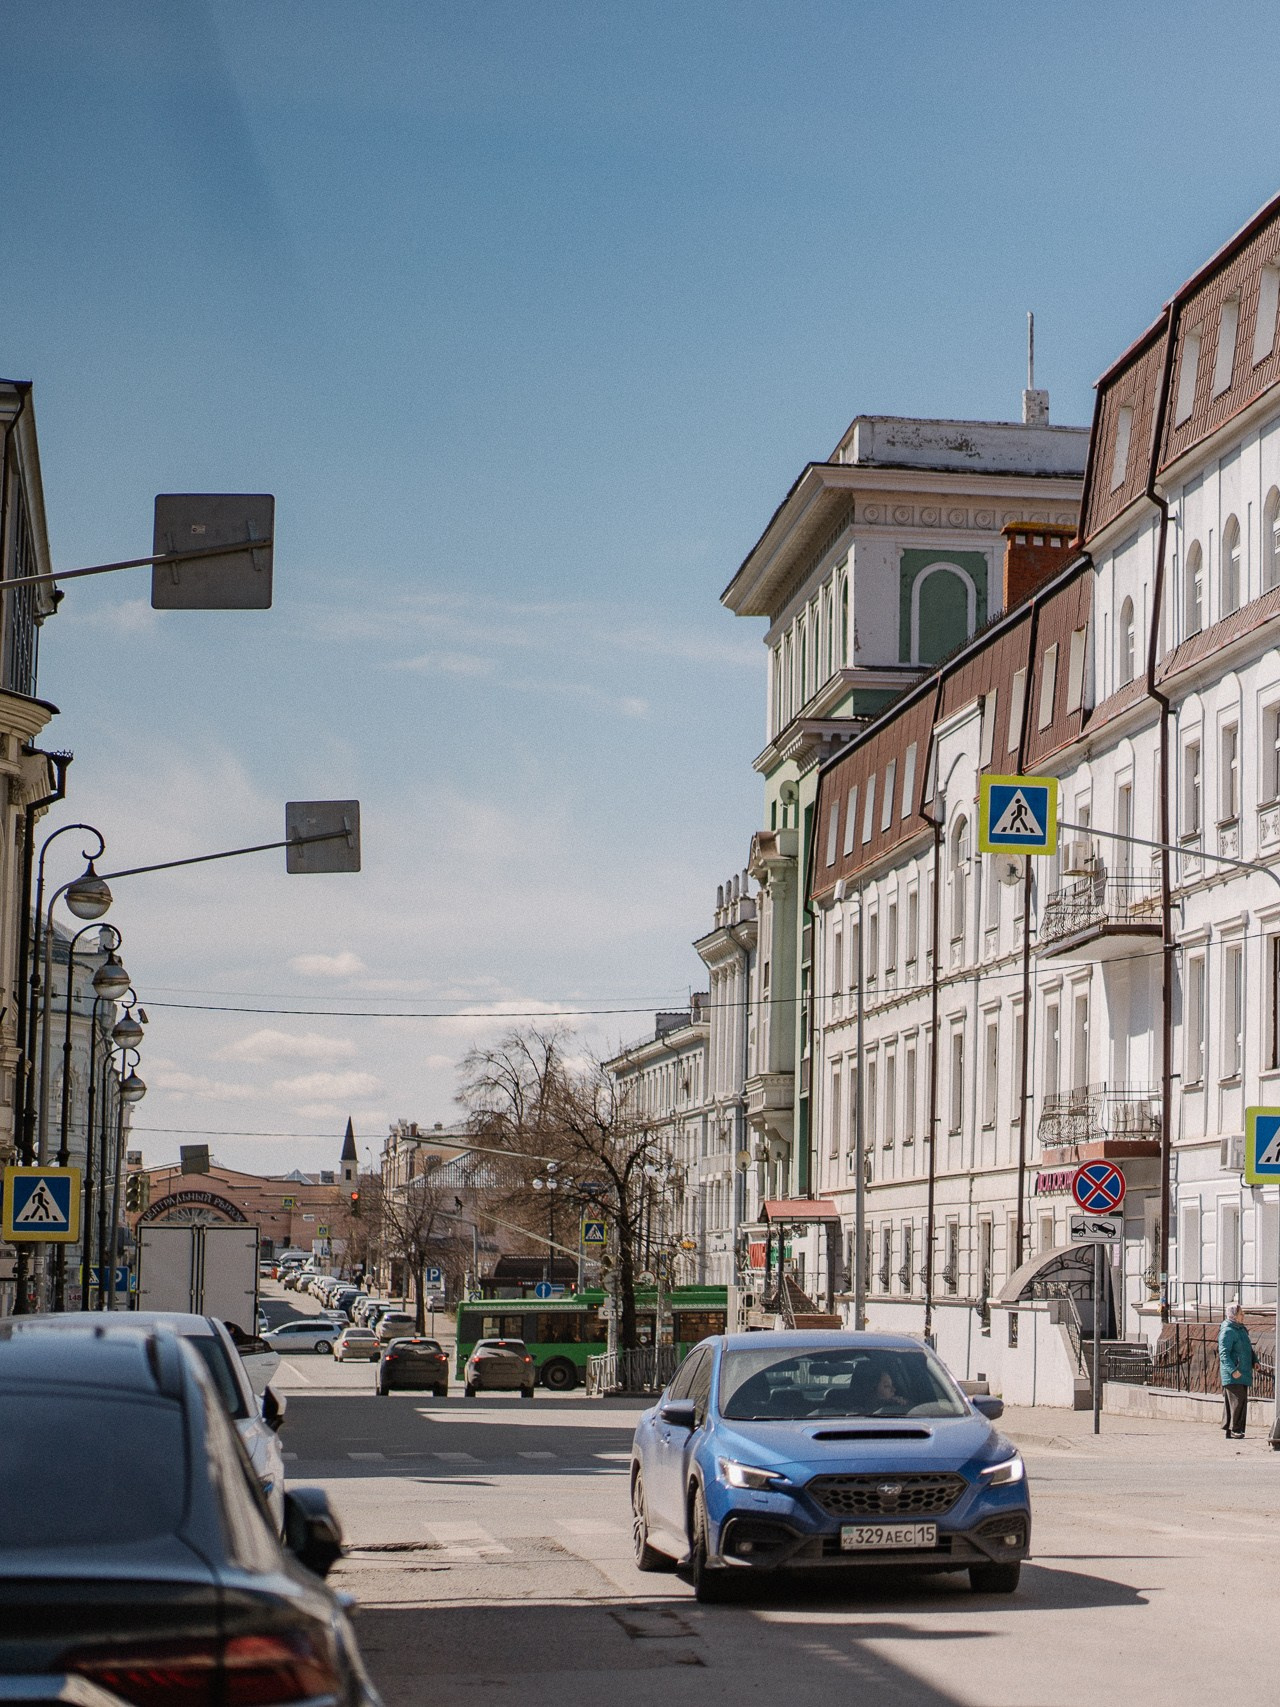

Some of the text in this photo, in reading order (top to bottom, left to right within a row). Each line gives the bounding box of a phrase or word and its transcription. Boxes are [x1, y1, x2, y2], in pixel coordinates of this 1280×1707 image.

[855, 1529, 884, 1544] 329
[885, 1531, 913, 1543] AEC
[917, 1526, 935, 1542] 15
